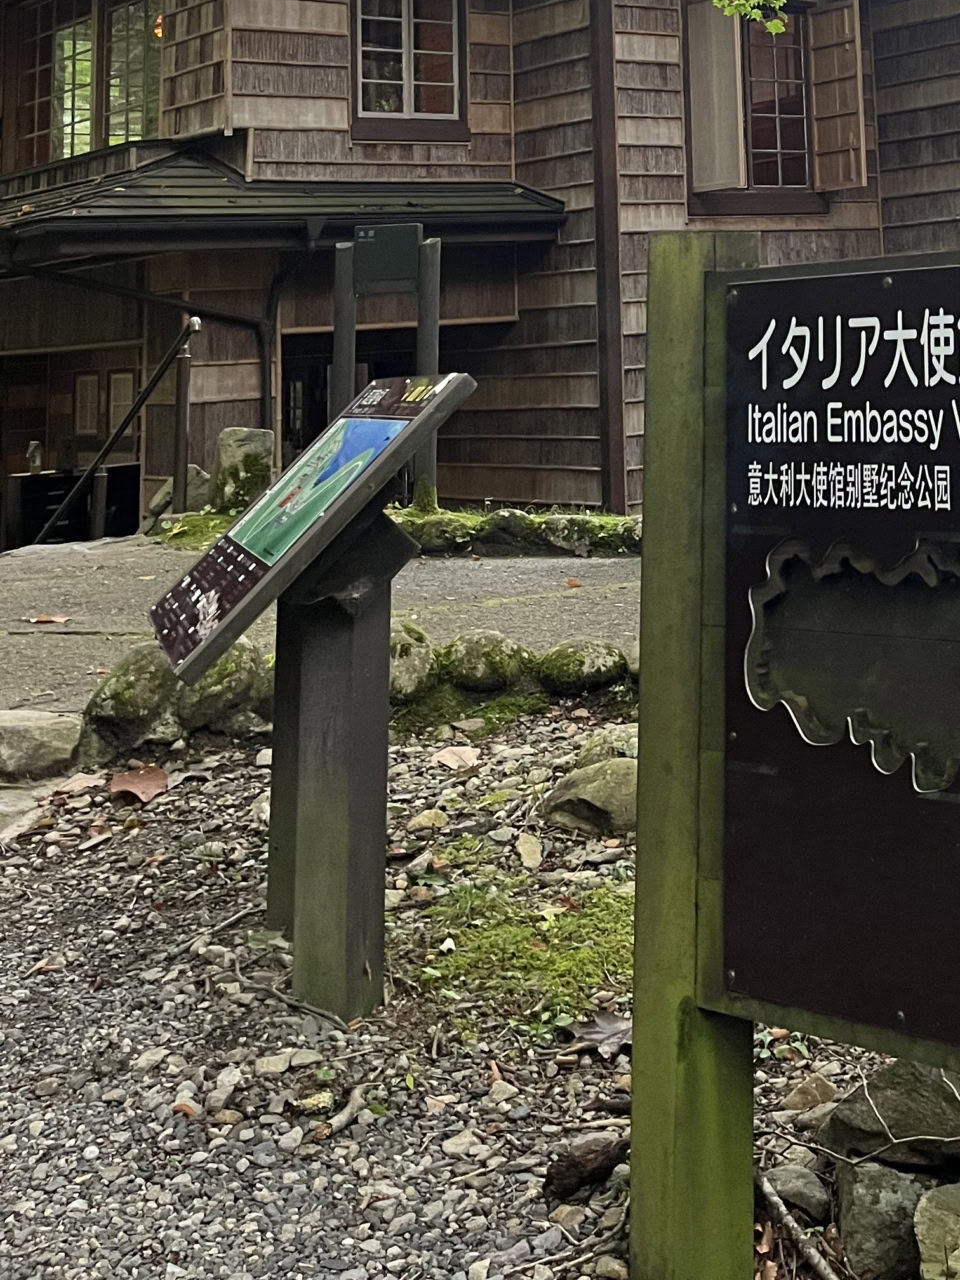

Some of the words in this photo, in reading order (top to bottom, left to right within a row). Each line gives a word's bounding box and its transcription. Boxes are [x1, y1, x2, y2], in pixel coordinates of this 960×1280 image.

[747, 402, 818, 444] Italian
[826, 400, 944, 451] Embassy
[747, 460, 951, 512] 意大利大使馆别墅纪念公园
